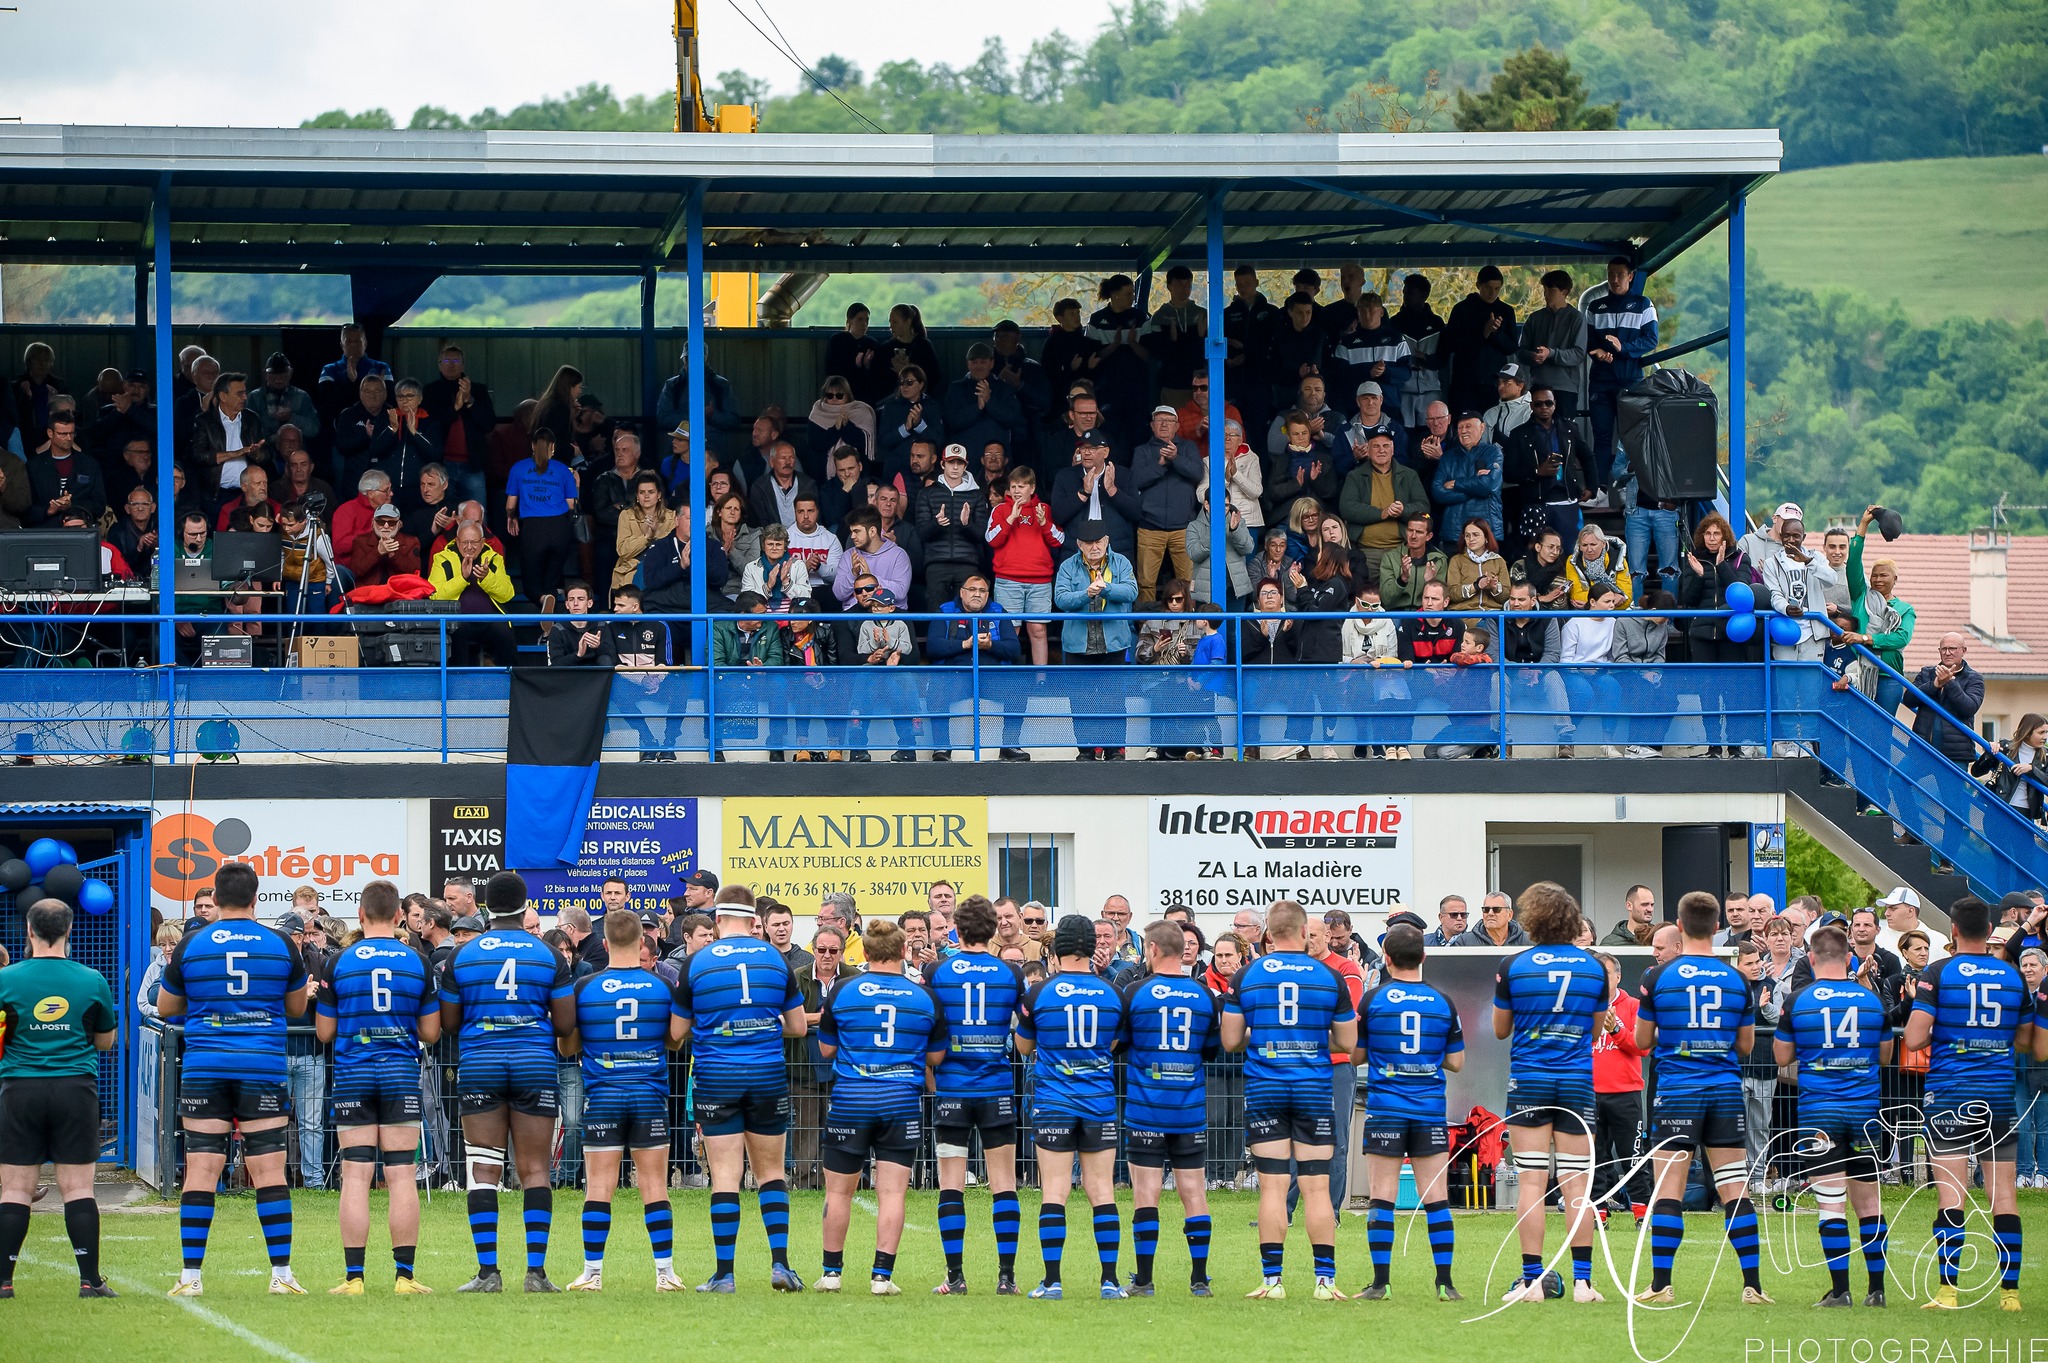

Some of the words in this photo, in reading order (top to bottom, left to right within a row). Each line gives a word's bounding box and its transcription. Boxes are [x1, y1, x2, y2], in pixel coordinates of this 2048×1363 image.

[457, 807, 486, 817] TAXI
[632, 822, 655, 830] CPAM
[441, 829, 502, 846] TAXIS
[603, 838, 661, 854] PRIVÉS
[738, 814, 973, 849] MANDIER
[444, 855, 500, 871] LUYA
[567, 868, 601, 877] Véhicules
[602, 869, 608, 877] 5
[609, 869, 617, 877] et
[618, 869, 623, 877] 7
[624, 868, 648, 878] places
[598, 857, 620, 866] toutes
[621, 857, 655, 866] distances
[661, 847, 694, 865] 24H/24
[670, 861, 690, 874] 7J/7
[729, 856, 799, 869] TRAVAUX
[803, 856, 862, 869] PUBLICS
[866, 855, 877, 868] &
[880, 855, 981, 868] PARTICULIERS
[1198, 861, 1227, 878] ZA
[1233, 861, 1258, 878] La
[1264, 860, 1362, 878] Maladière
[527, 899, 540, 910] 04
[542, 899, 555, 910] 76
[558, 899, 570, 909] 36
[589, 899, 602, 909] 00
[644, 898, 656, 909] 50
[544, 885, 553, 893] 12
[554, 884, 565, 893] bis
[580, 884, 589, 893] de
[628, 884, 646, 893] 8470
[648, 884, 671, 893] VINAY
[766, 882, 780, 896] 04
[784, 882, 799, 896] 76
[804, 882, 818, 896] 36
[822, 882, 836, 895] 81
[869, 881, 907, 896] 38470
[911, 881, 964, 895] VIY
[1160, 889, 1219, 906] 38160
[1225, 889, 1290, 906] SAINT
[1296, 888, 1401, 906] SAUVEUR
[226, 952, 249, 995] 5
[371, 968, 392, 1012] 6
[494, 958, 518, 1000] 4
[736, 963, 752, 1005] 1
[962, 982, 987, 1025] 11
[1278, 982, 1299, 1026] 8
[1548, 970, 1572, 1013] 7
[1686, 985, 1722, 1028] 12
[1966, 983, 2002, 1027] 15
[616, 998, 638, 1040] 2
[873, 1004, 896, 1048] 3
[1064, 1004, 1098, 1048] 10
[1158, 1006, 1192, 1051] 13
[1400, 1010, 1421, 1054] 9
[1820, 1006, 1860, 1048] 14
